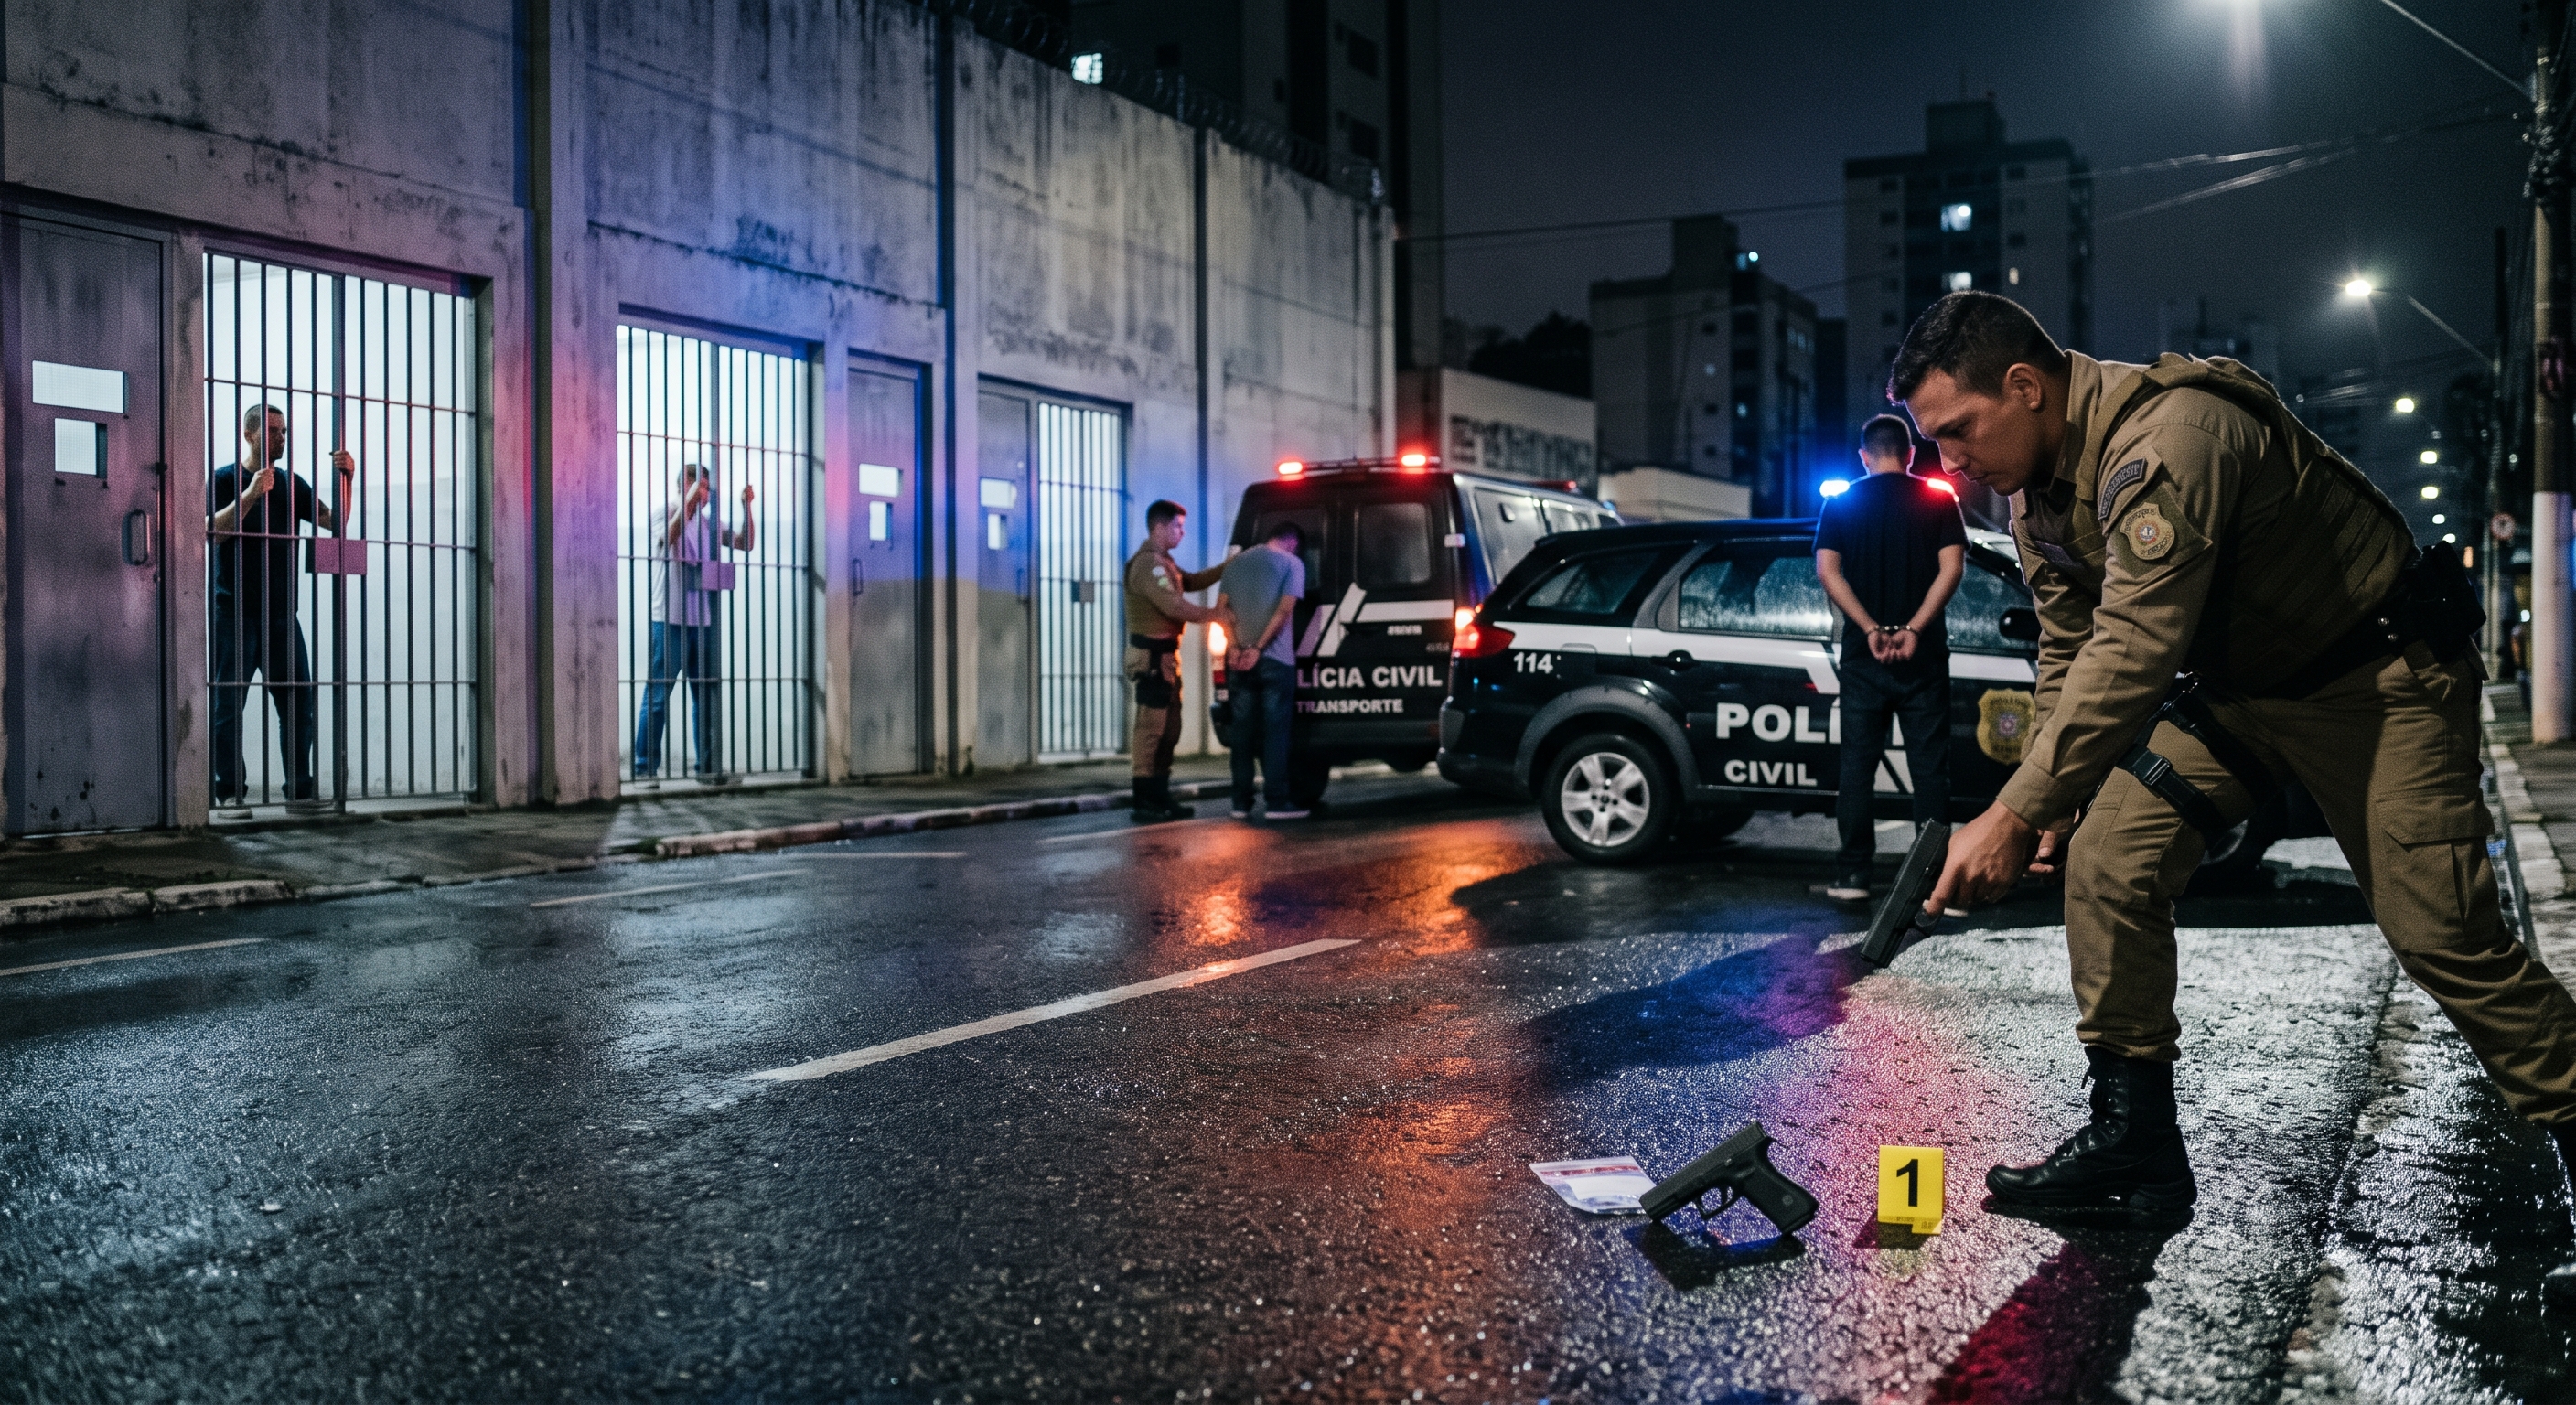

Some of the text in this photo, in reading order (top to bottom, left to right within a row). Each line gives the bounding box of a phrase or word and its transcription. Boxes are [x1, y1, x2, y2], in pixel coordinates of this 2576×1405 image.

[1297, 663, 1443, 688] LÍCIA CIVIL
[1513, 651, 1553, 674] 114
[1296, 698, 1404, 713] TRANSPORTE
[1716, 696, 1905, 746] POLÍ
[1724, 759, 1818, 787] CIVIL
[1896, 1158, 1918, 1207] 1
